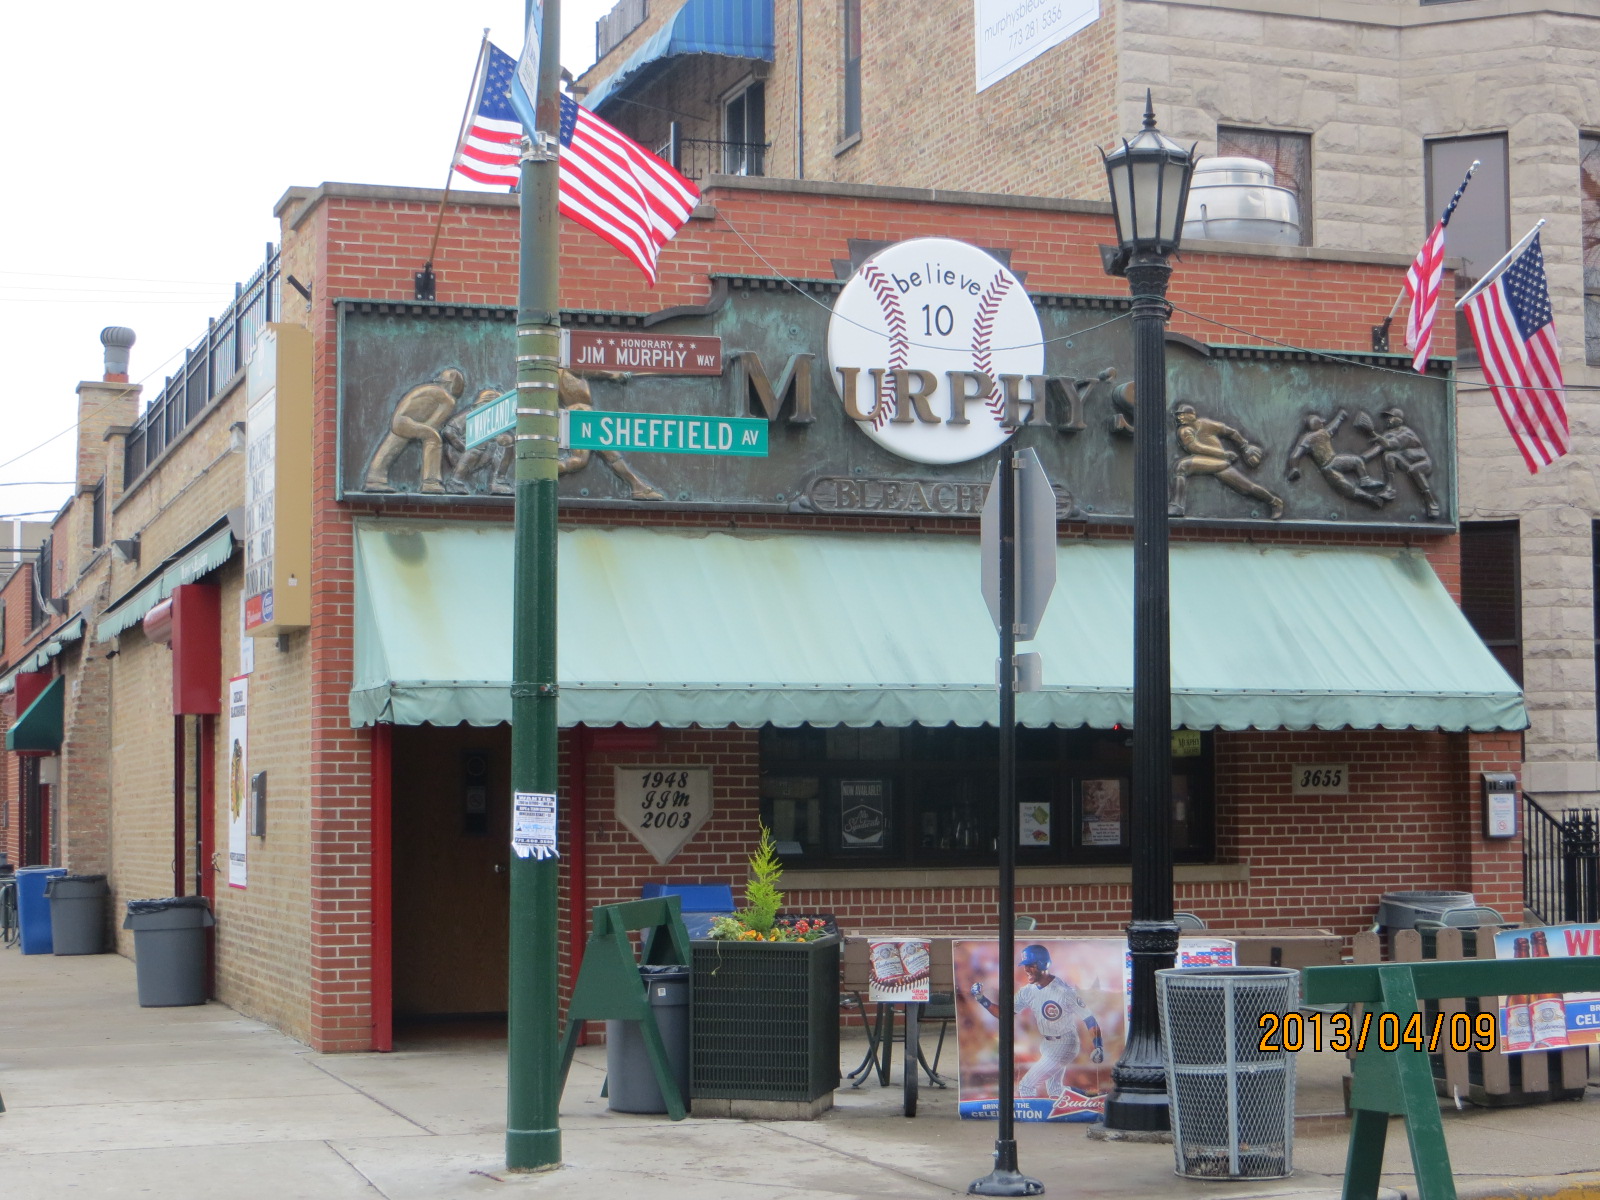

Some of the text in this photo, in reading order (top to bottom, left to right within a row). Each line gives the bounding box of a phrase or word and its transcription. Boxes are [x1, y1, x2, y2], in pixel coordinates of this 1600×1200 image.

[1008, 4, 1062, 52] 773 281 5356
[891, 262, 981, 296] believe
[922, 304, 954, 337] 10
[621, 338, 673, 349] HONORARY
[577, 346, 715, 368] JIM MURPHY WAY
[582, 416, 759, 451] N SHEFFIELD AV
[834, 480, 991, 513] BLEACH
[642, 771, 689, 788] 1948
[1300, 769, 1342, 788] 3655
[843, 784, 854, 796] NOW
[640, 811, 692, 829] 2003
